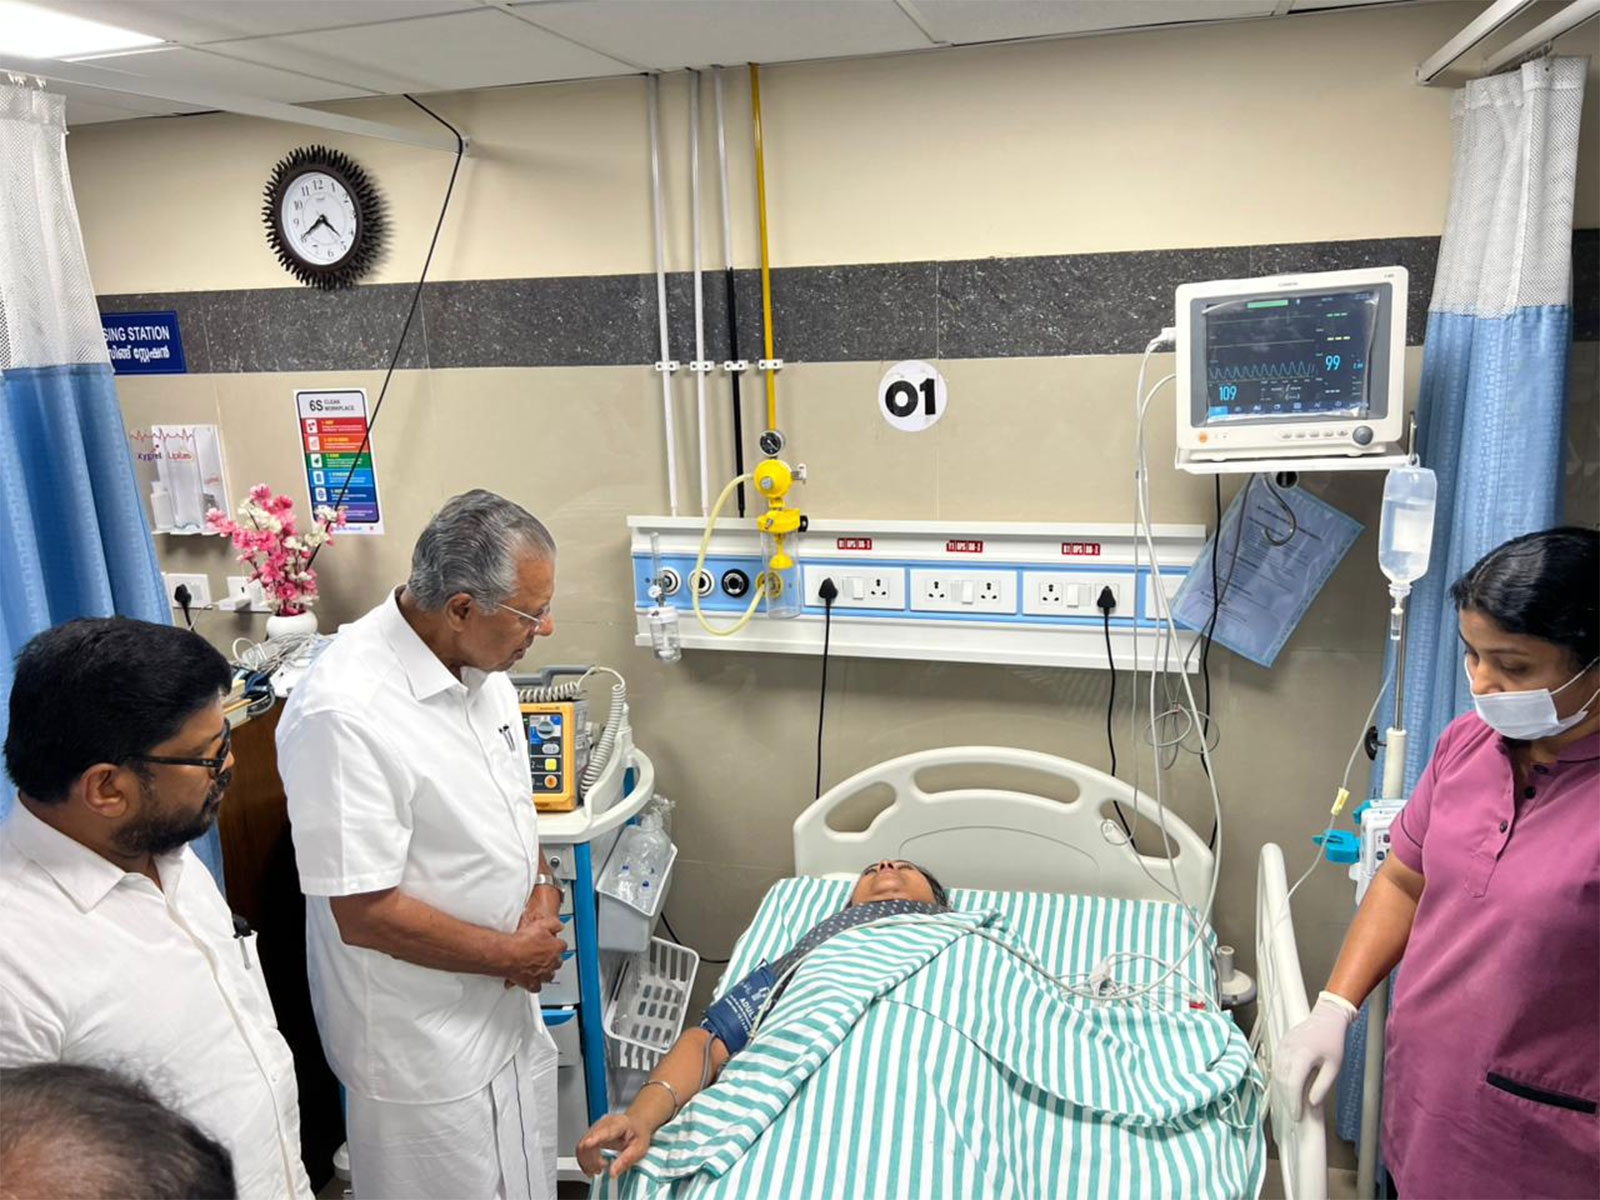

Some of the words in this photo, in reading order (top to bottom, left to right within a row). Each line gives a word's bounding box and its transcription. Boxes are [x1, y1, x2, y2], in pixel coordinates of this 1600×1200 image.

[301, 185, 310, 197] 11
[313, 179, 324, 191] 12
[331, 182, 336, 193] 1
[294, 200, 303, 211] 10
[293, 218, 300, 227] 9
[327, 249, 334, 257] 6
[127, 325, 170, 341] STATION
[1325, 355, 1341, 371] 99
[1219, 385, 1237, 401] 109
[309, 399, 324, 412] 6S
